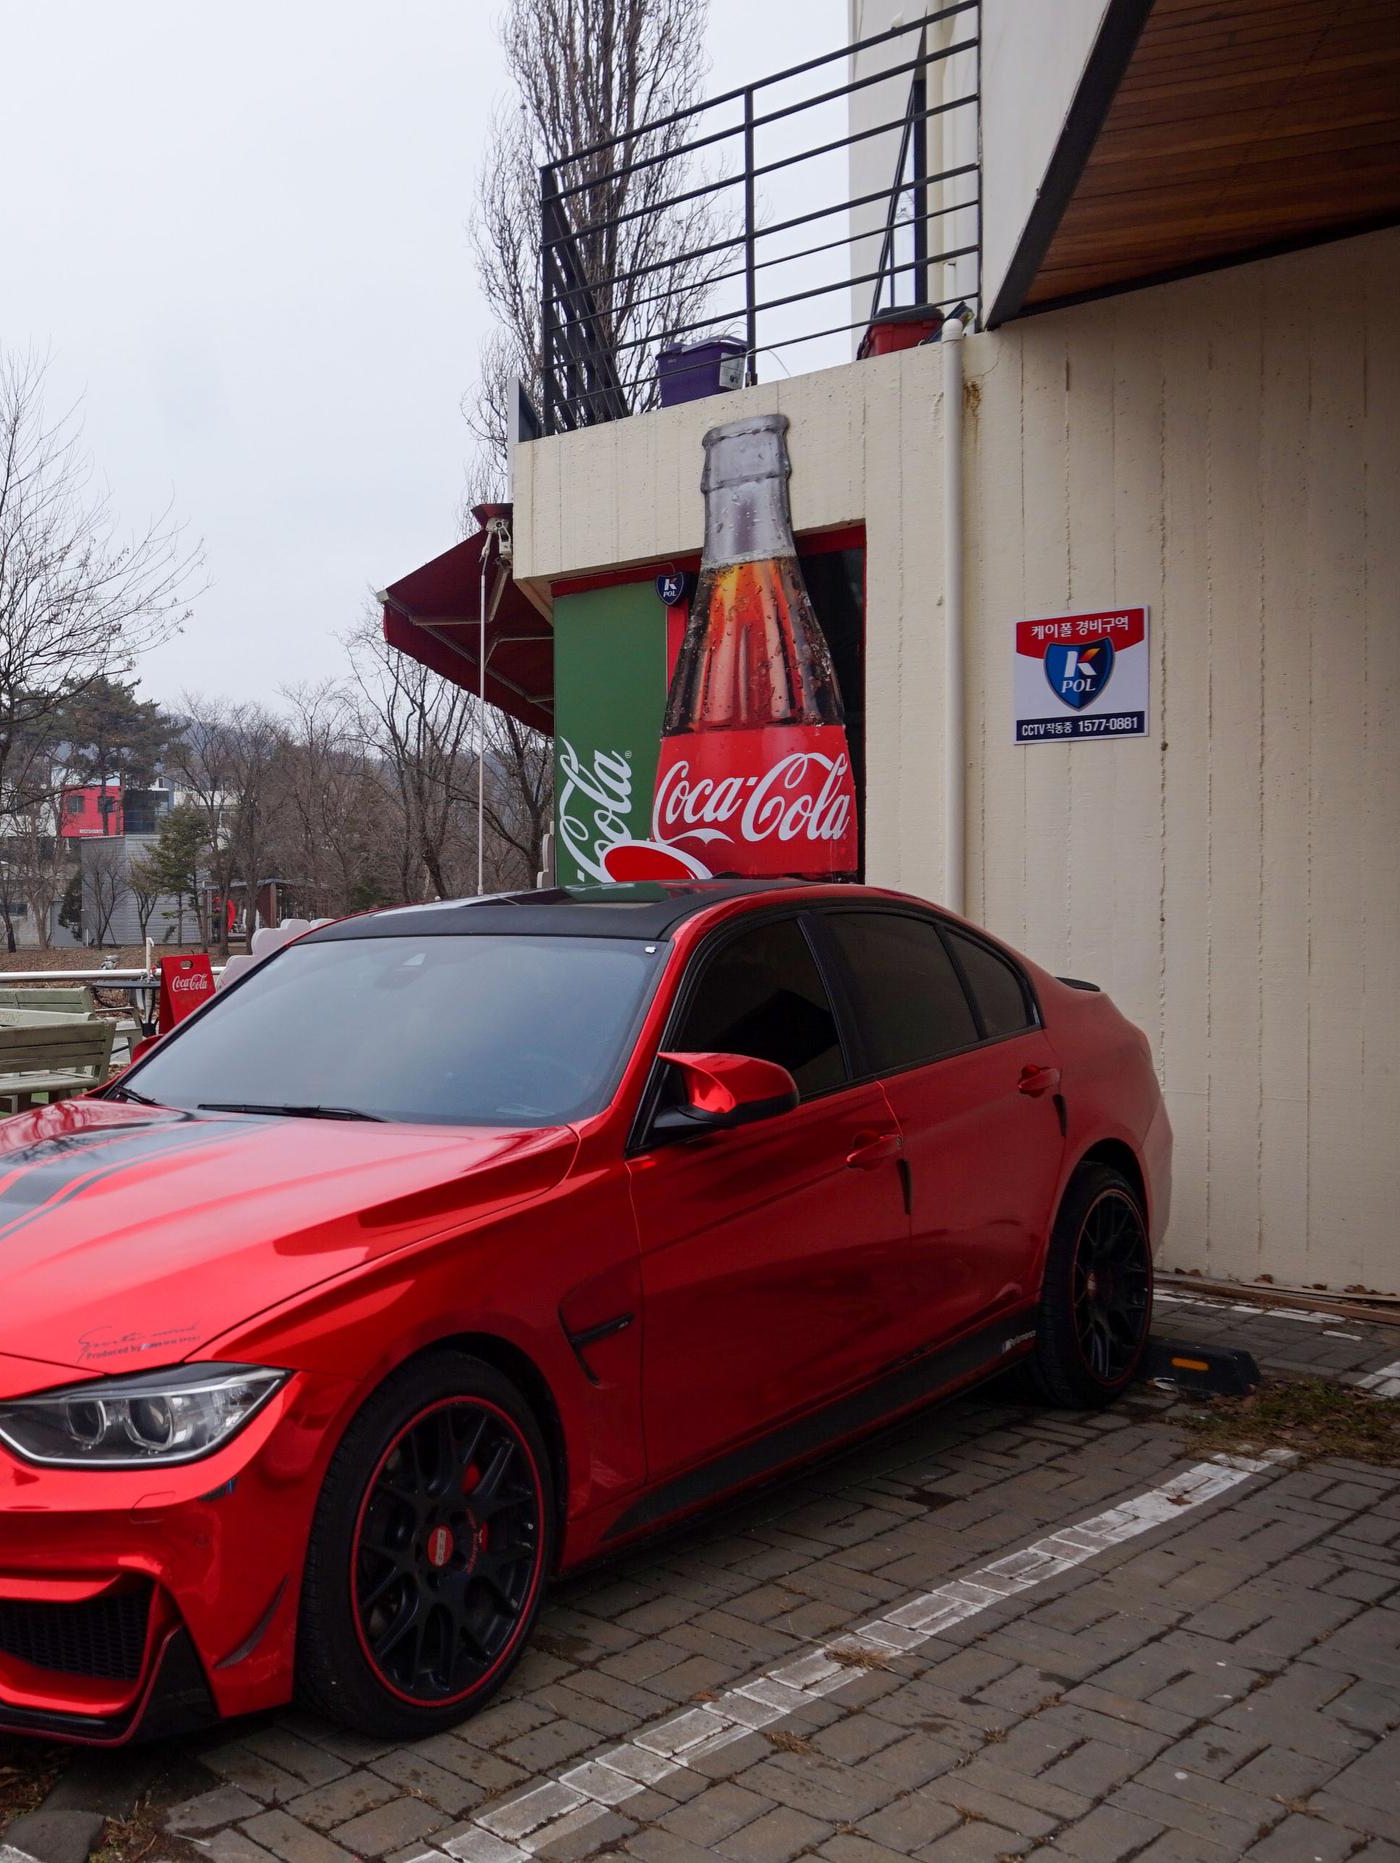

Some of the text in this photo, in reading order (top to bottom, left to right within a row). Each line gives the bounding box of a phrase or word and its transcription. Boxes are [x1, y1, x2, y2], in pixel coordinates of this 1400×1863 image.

[1031, 616, 1129, 640] 케이폴 경비구역
[1064, 648, 1100, 677] K
[1061, 679, 1096, 693] POL
[1078, 717, 1138, 732] 1577-0881
[652, 752, 850, 845] Coca-Cola
[172, 974, 208, 992] Coca-Cola
